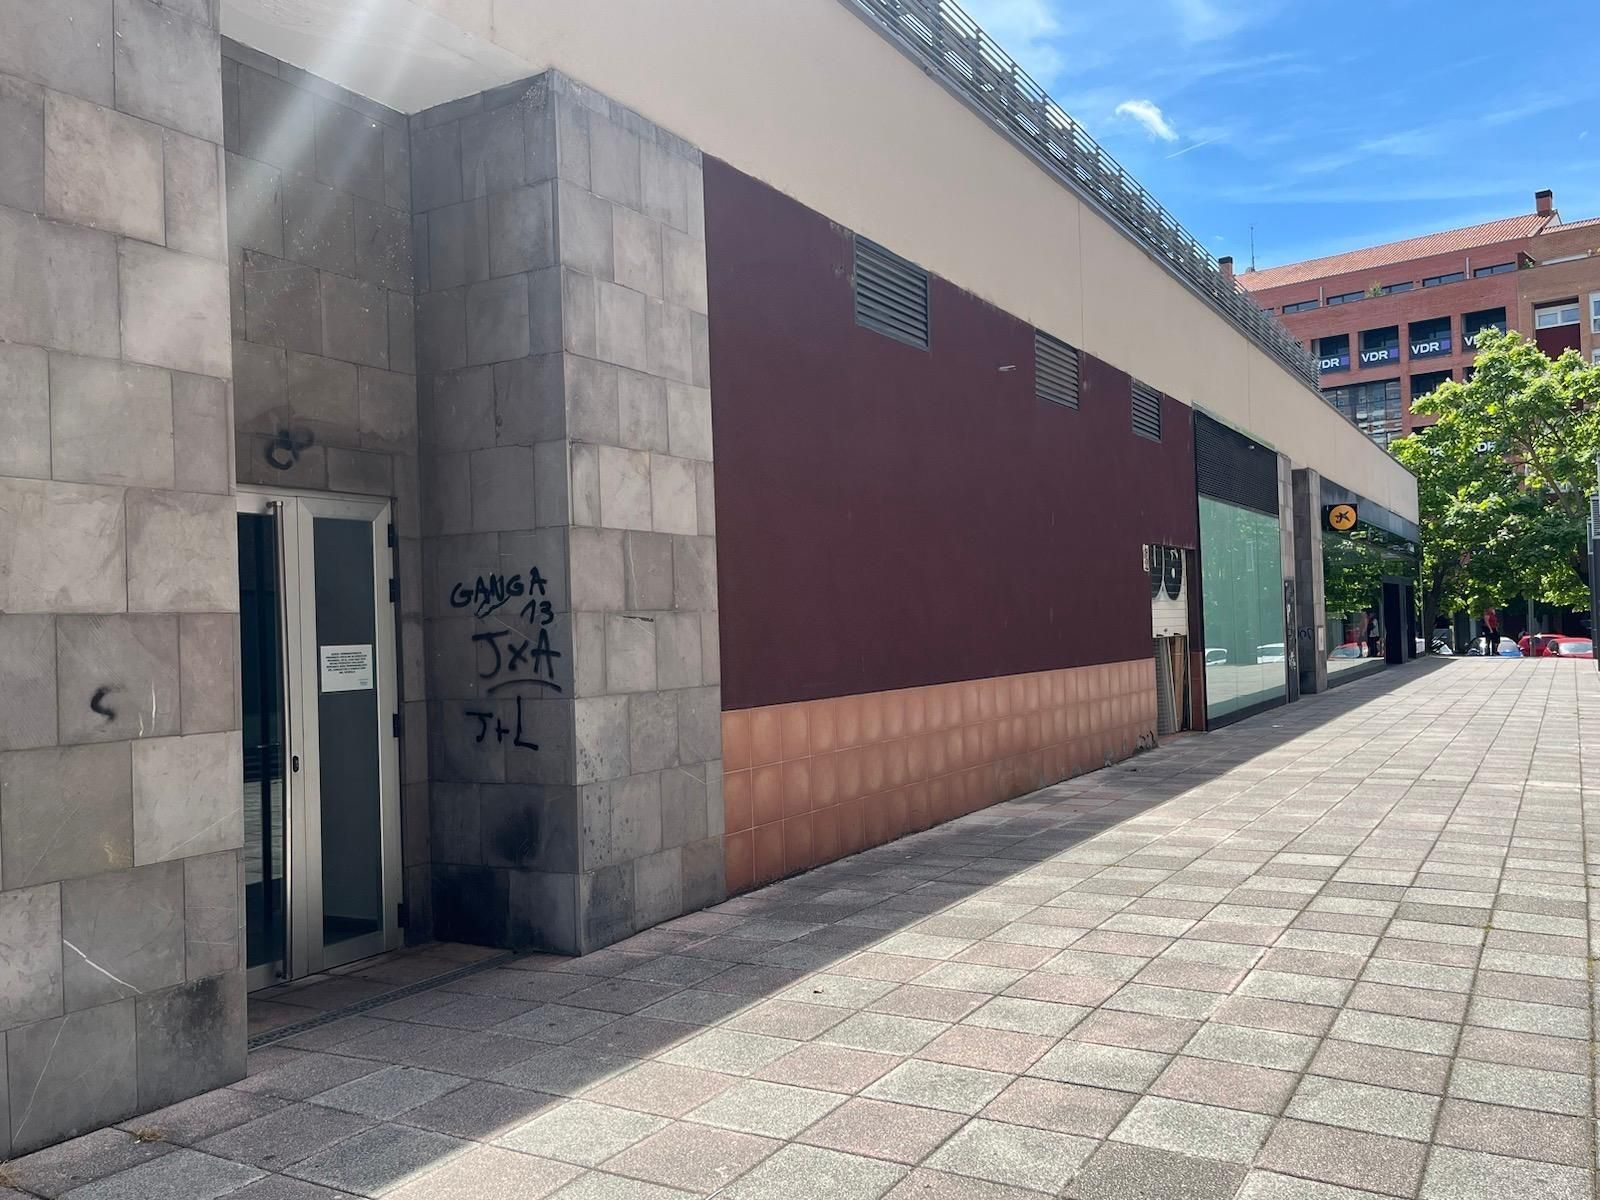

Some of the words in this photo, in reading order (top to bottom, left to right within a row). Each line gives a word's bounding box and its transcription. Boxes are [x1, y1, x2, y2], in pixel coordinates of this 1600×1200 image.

[1361, 350, 1388, 363] VDR
[1411, 342, 1439, 355] VDR
[450, 566, 548, 609] GANGA
[520, 598, 554, 625] 13
